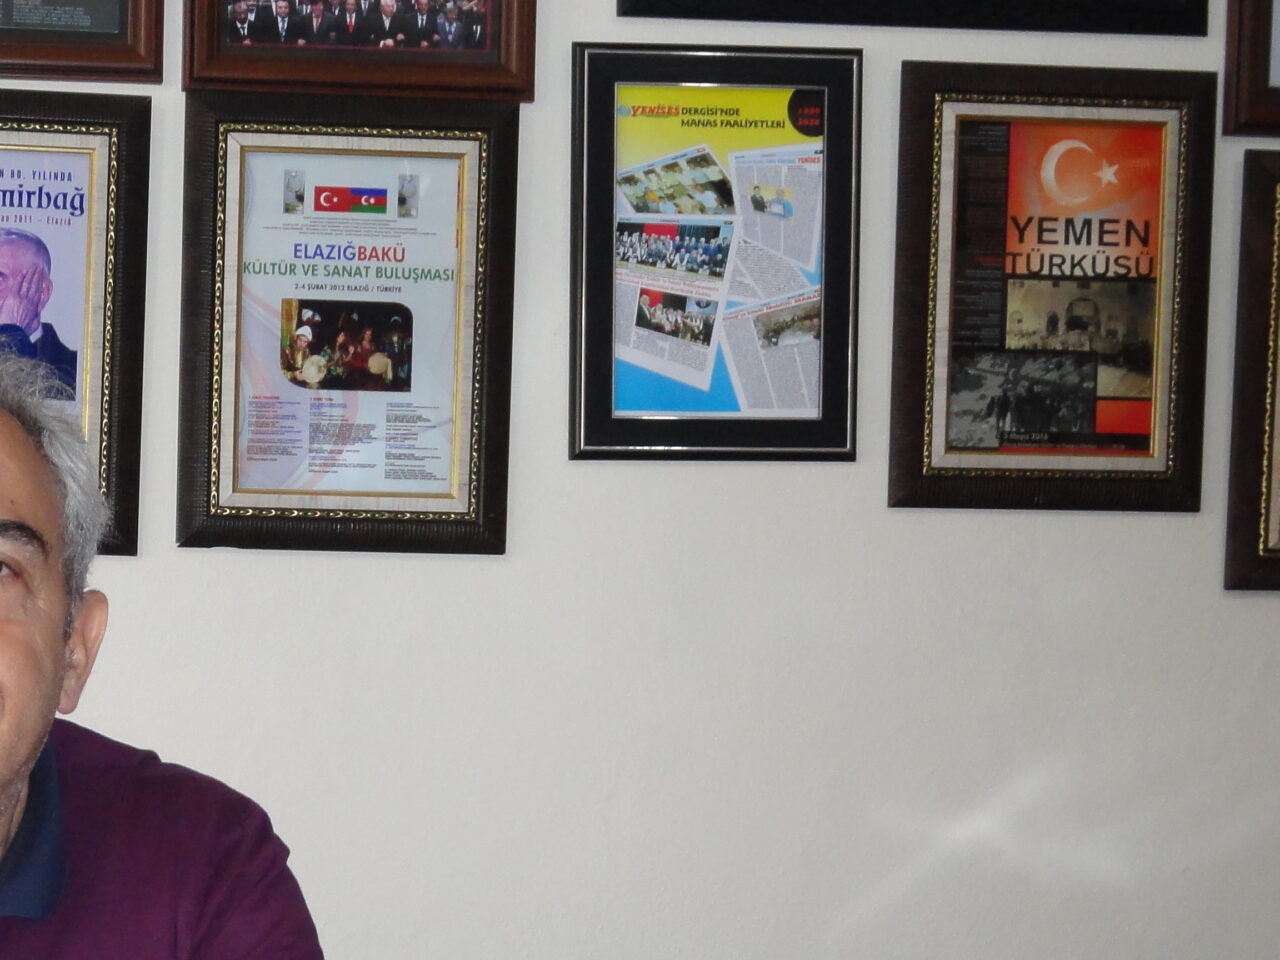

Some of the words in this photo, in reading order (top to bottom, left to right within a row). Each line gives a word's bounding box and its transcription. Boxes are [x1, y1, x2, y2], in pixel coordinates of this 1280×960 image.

[680, 119, 718, 128] MANAS
[720, 120, 786, 129] FAALİYETLERİ
[32, 170, 72, 182] YILINDA
[1011, 216, 1150, 248] YEMEN
[243, 258, 297, 276] KÜLTÜR
[301, 264, 318, 276] VE
[324, 264, 371, 278] SANAT
[376, 266, 454, 284] BULUŞMASI
[1006, 248, 1154, 278] TÜRKÜSÜ
